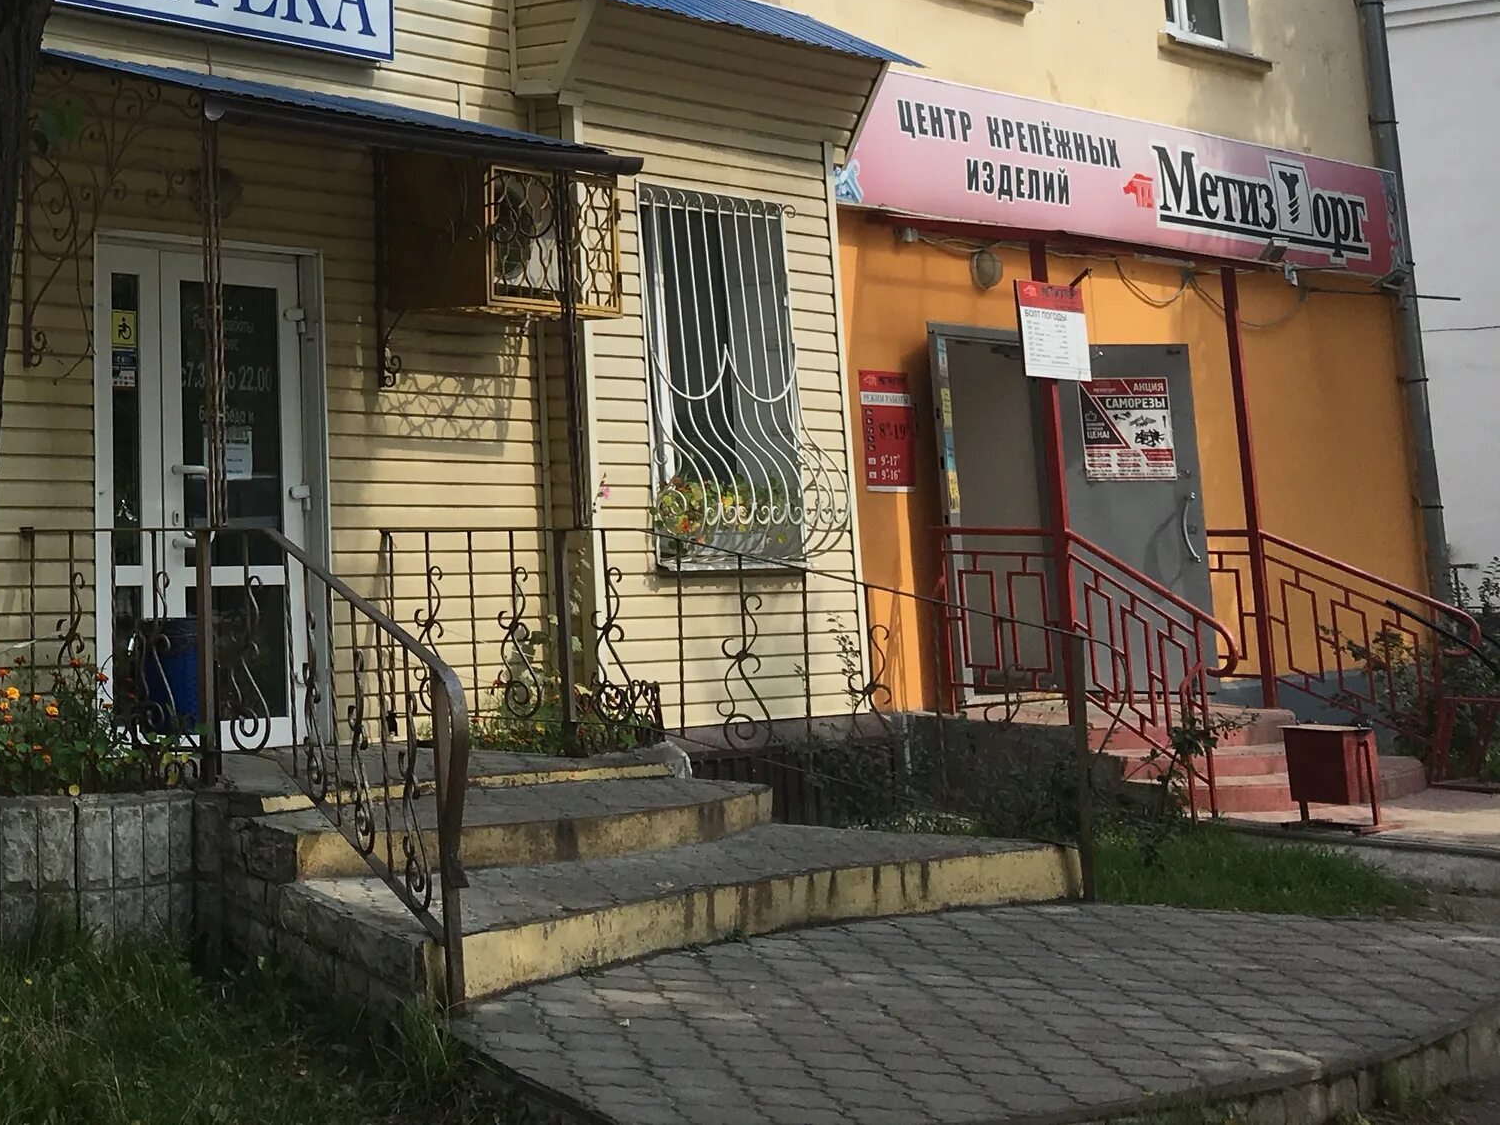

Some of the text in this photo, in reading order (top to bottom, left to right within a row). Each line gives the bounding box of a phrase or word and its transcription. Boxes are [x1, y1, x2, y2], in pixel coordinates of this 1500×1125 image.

[896, 98, 1121, 169] ЦЕНТР КРЕПЁЖНЫХ
[965, 156, 1070, 206] ИЗДЕЛИЙ
[1105, 397, 1166, 409] САМОРЕЗЫ
[1133, 382, 1165, 393] АКЦИЯ
